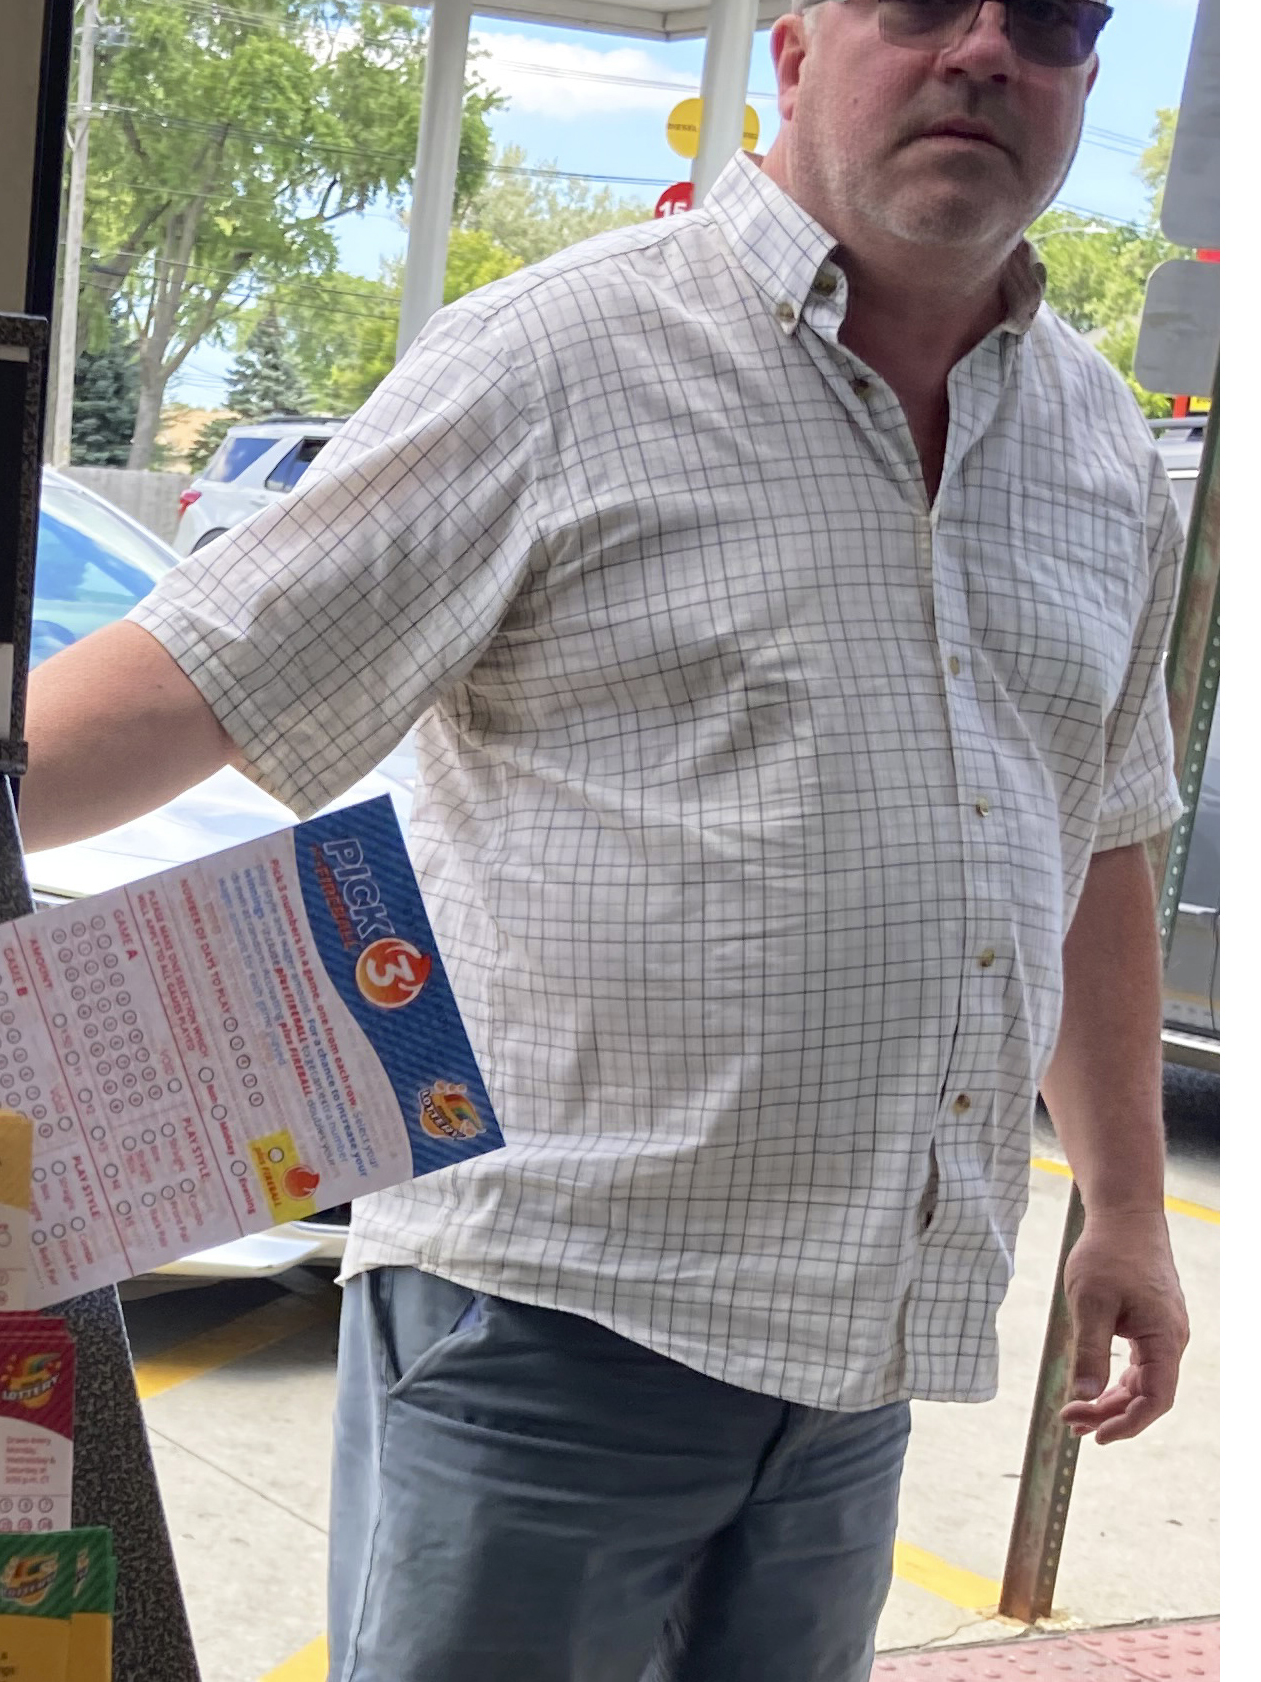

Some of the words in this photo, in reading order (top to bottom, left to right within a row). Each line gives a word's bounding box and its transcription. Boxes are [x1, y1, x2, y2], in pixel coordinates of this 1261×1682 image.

[268, 857, 285, 884] Pick
[178, 877, 202, 925] NUMBER
[276, 883, 288, 893] 3
[279, 893, 305, 944] numbers
[323, 836, 395, 937] PICK
[366, 953, 415, 988] 3
[112, 908, 133, 946] GAME
[125, 947, 139, 961] A
[194, 926, 207, 941] OF
[200, 942, 217, 970] DAYS
[297, 945, 309, 957] in
[301, 958, 311, 966] a
[209, 970, 222, 986] TO
[301, 967, 323, 1003] game,
[214, 987, 231, 1014] PLAY
[315, 1003, 330, 1026] one
[323, 1026, 341, 1055] from
[333, 1055, 351, 1083] each
[343, 1084, 358, 1108] row.
[352, 1111, 371, 1144] Select
[419, 1089, 460, 1140] LOTTERY
[361, 1144, 378, 1170] your
[1, 1371, 63, 1402] LOTTERY
